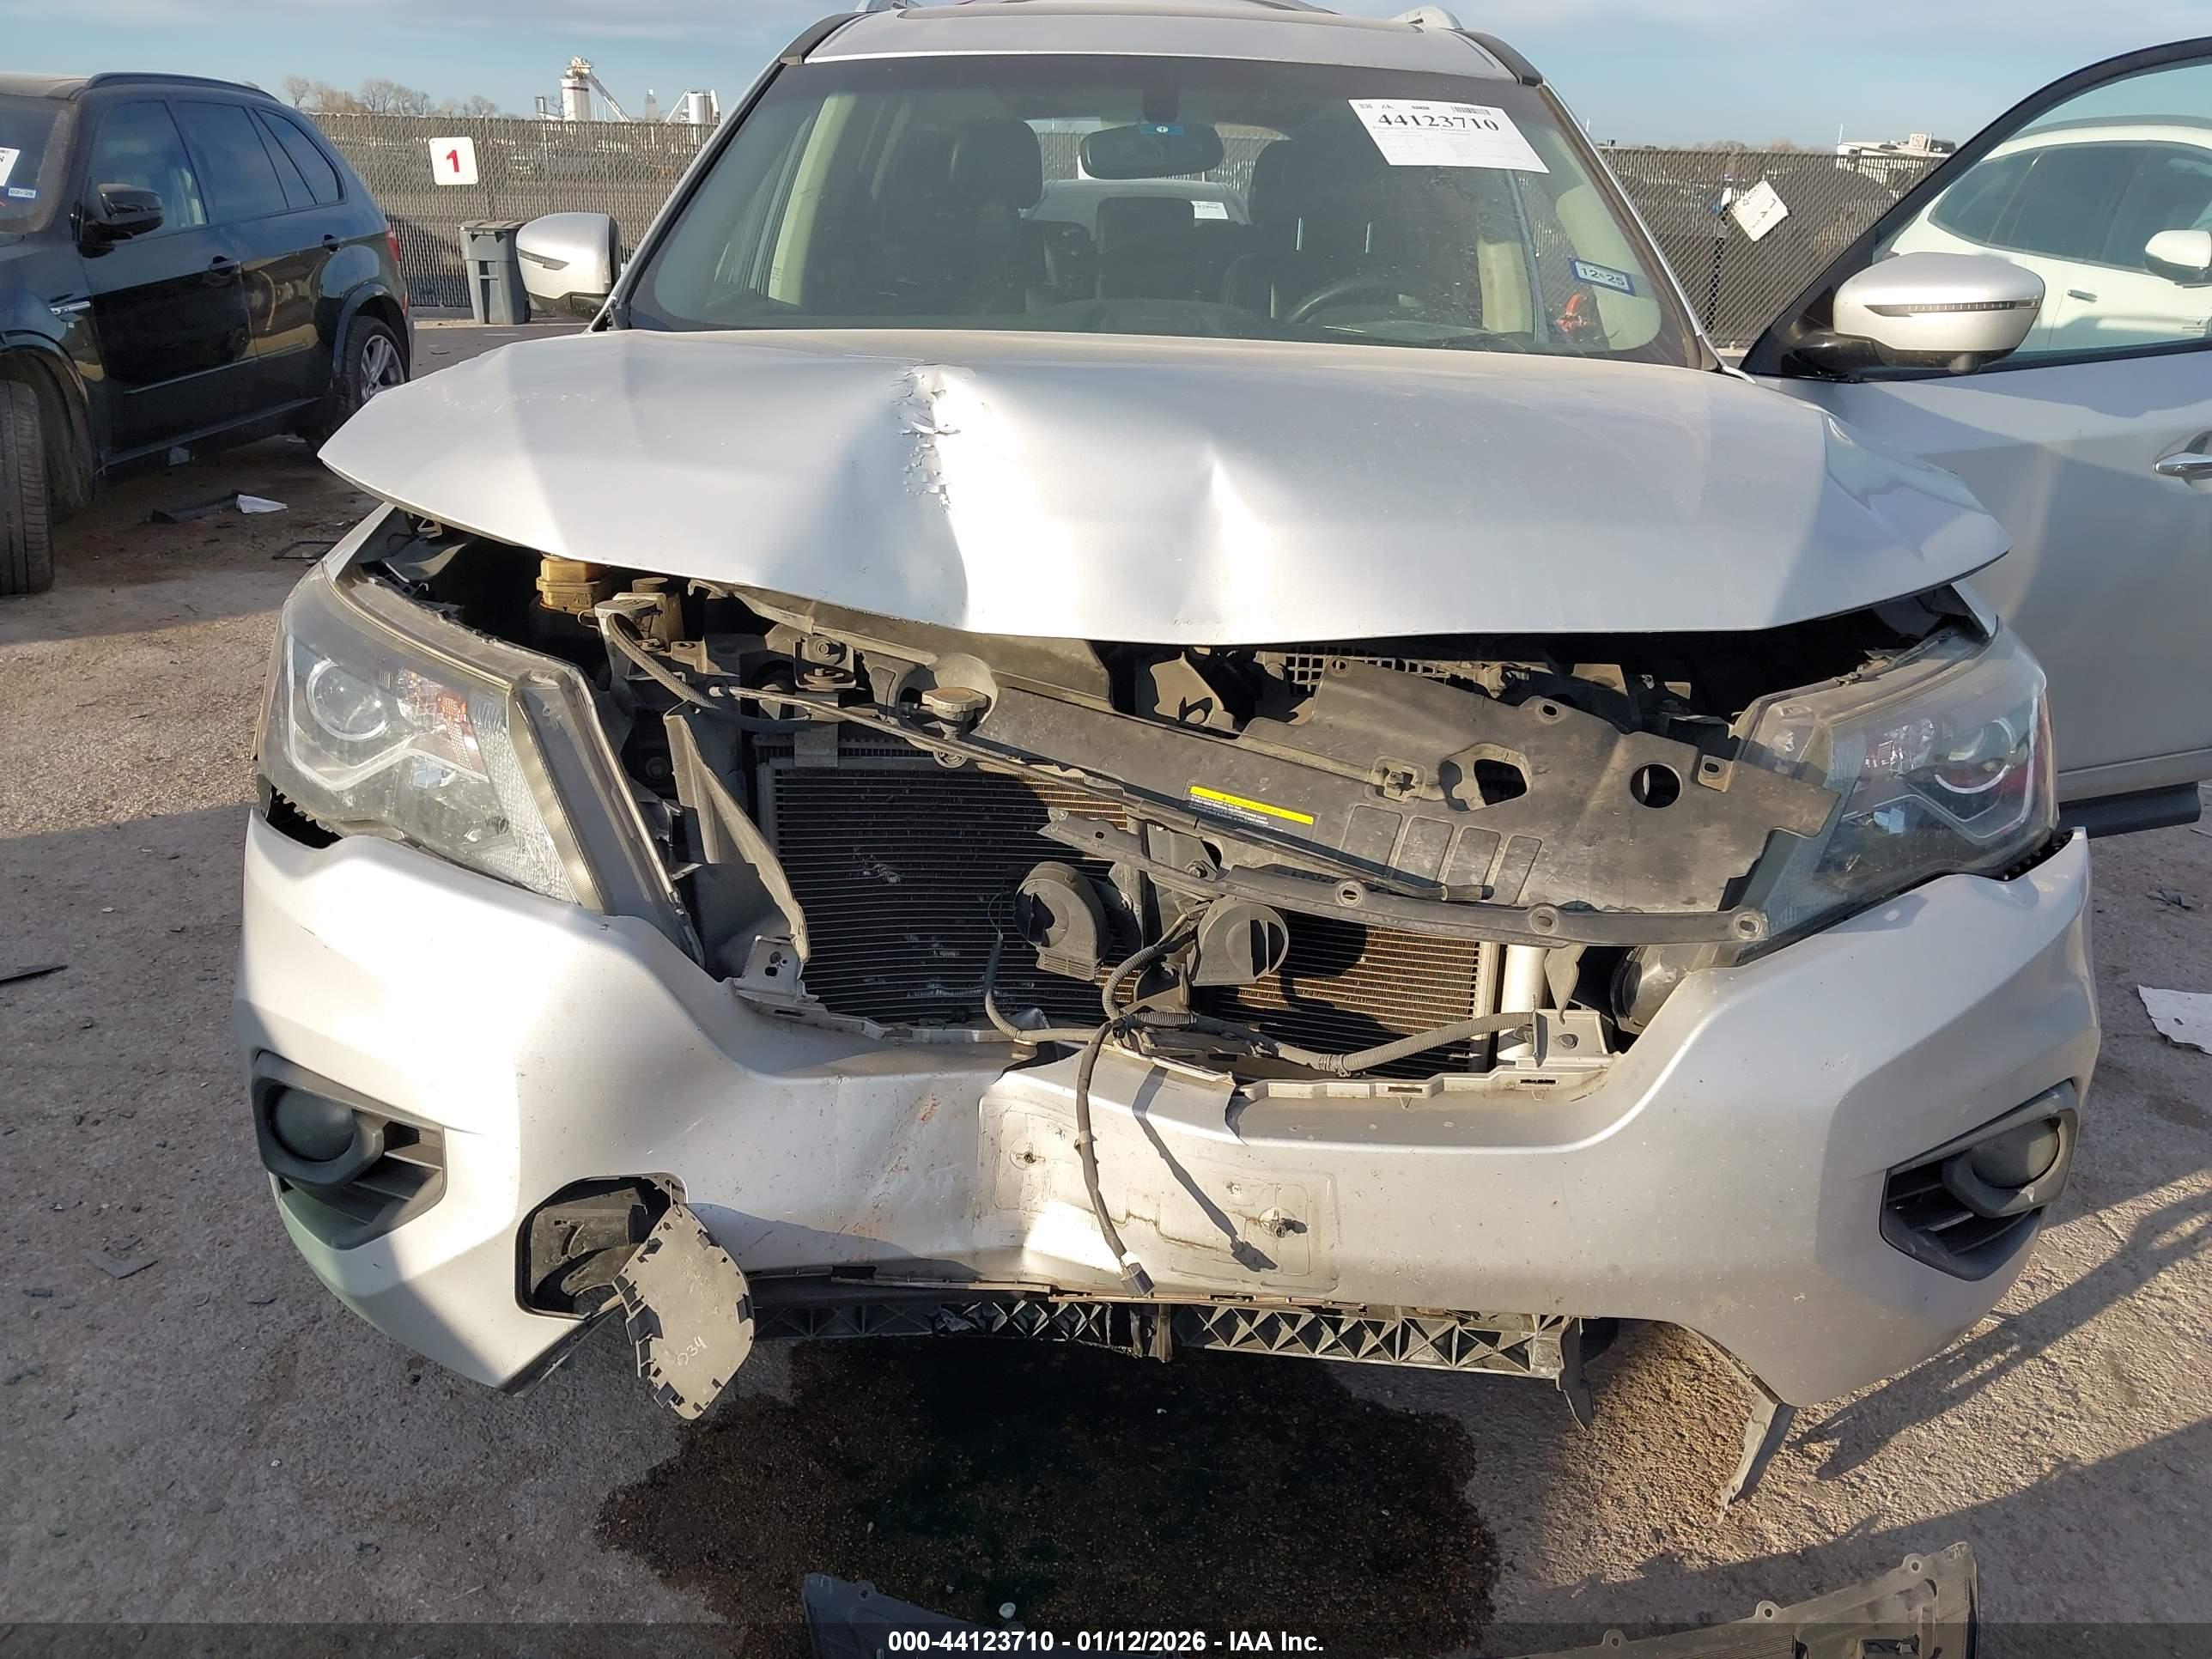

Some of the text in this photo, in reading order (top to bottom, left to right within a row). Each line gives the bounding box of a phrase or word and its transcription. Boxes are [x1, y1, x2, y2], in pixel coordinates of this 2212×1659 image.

[1378, 113, 1499, 131] 44123710
[446, 149, 460, 173] 1
[1580, 267, 1626, 287] 12-25
